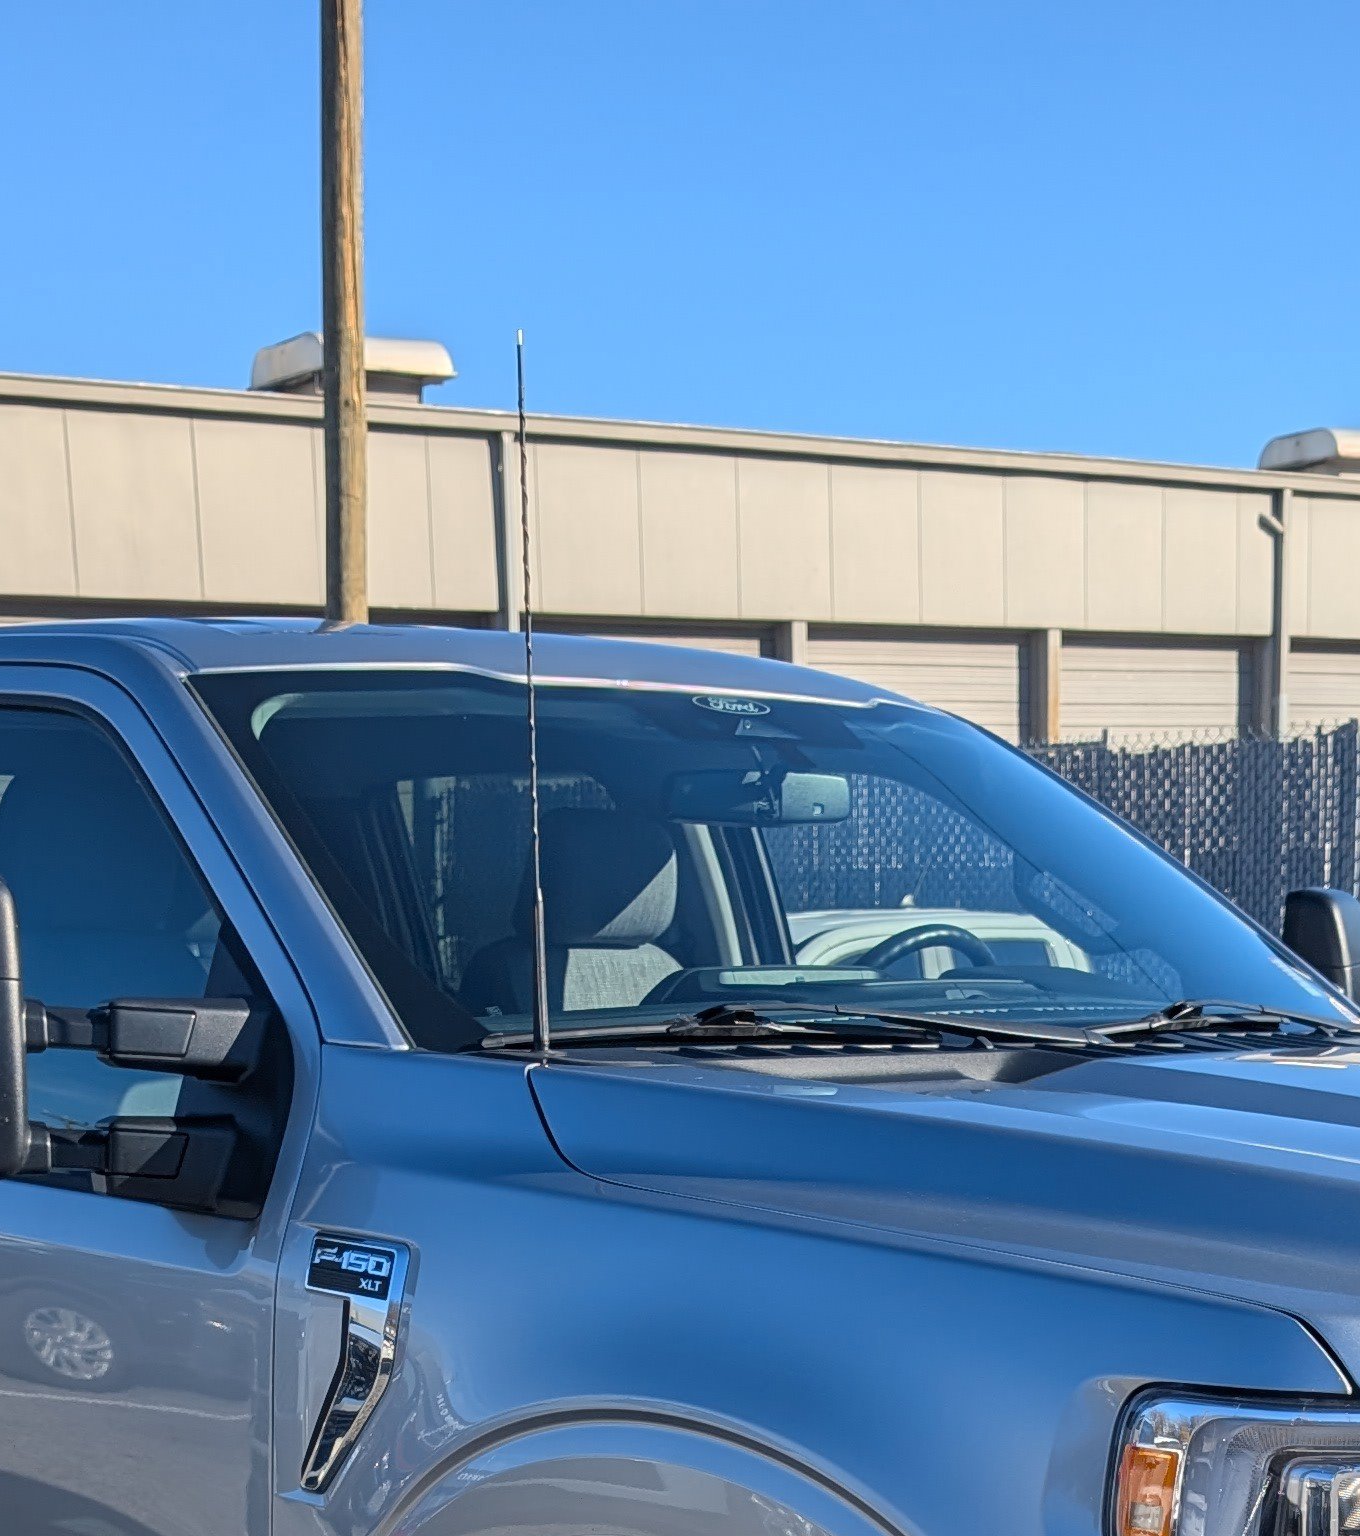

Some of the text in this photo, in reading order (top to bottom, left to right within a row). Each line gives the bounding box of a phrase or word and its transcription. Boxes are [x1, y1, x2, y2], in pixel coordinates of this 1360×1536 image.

[707, 696, 759, 713] Ford
[313, 1246, 391, 1277] F-150
[359, 1278, 383, 1291] XLT
